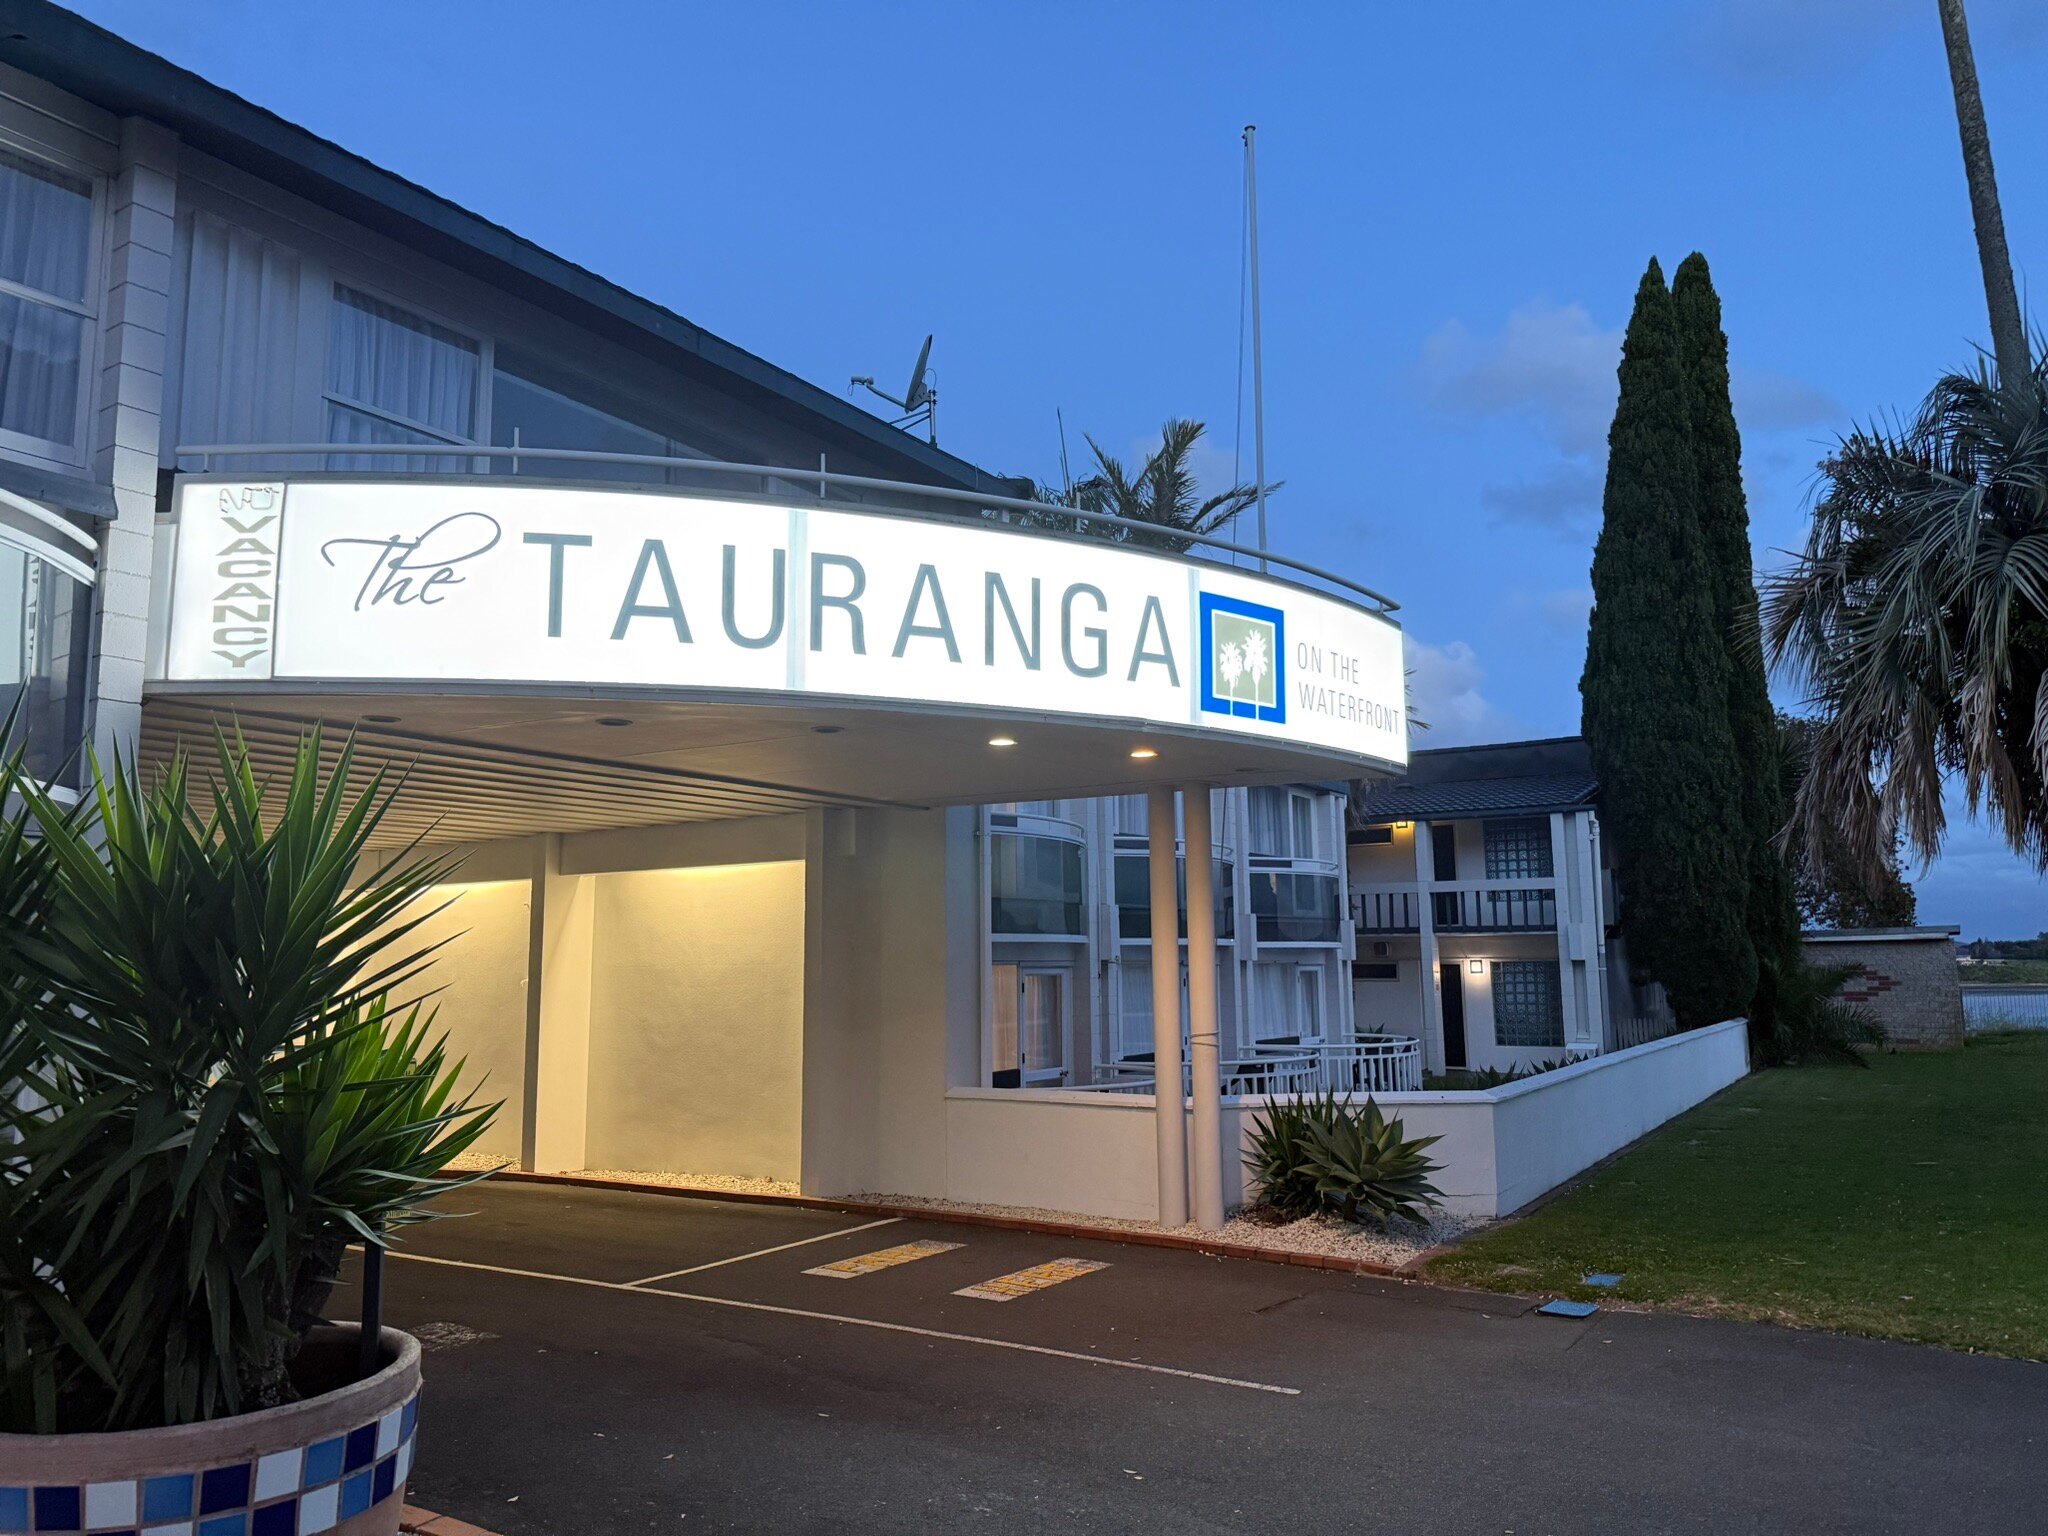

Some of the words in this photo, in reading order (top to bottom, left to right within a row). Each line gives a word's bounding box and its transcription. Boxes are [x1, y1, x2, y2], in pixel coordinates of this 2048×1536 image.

[211, 515, 279, 668] VACANCY
[320, 511, 502, 612] The
[522, 531, 1181, 688] TAURANGA
[1297, 642, 1322, 674] ON
[1330, 651, 1359, 685] THE
[1298, 681, 1400, 735] WATERFRONT
